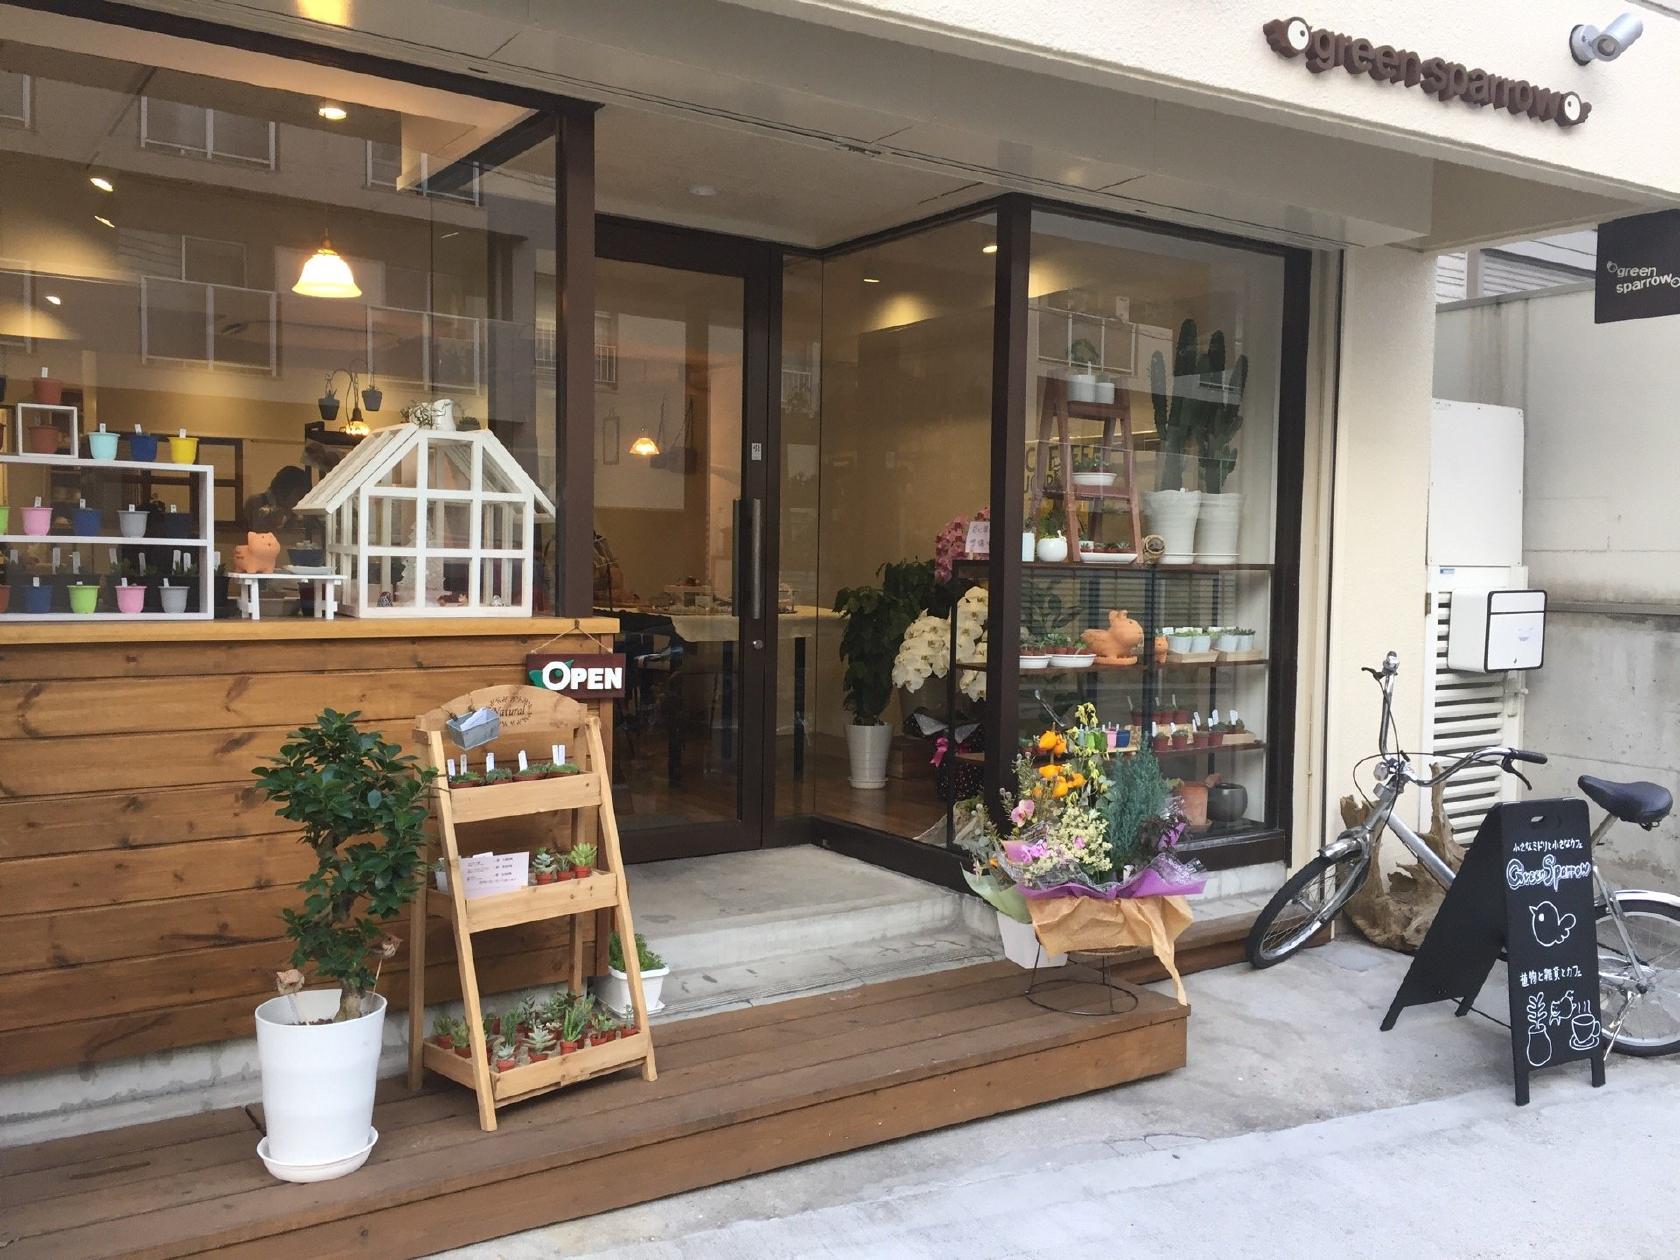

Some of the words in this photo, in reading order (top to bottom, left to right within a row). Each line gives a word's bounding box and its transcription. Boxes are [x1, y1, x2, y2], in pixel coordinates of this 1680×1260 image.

[1306, 29, 1421, 88] green
[1421, 57, 1562, 122] sparrow
[1616, 273, 1672, 294] sparrow
[1617, 267, 1657, 278] green
[543, 661, 622, 691] OPEN
